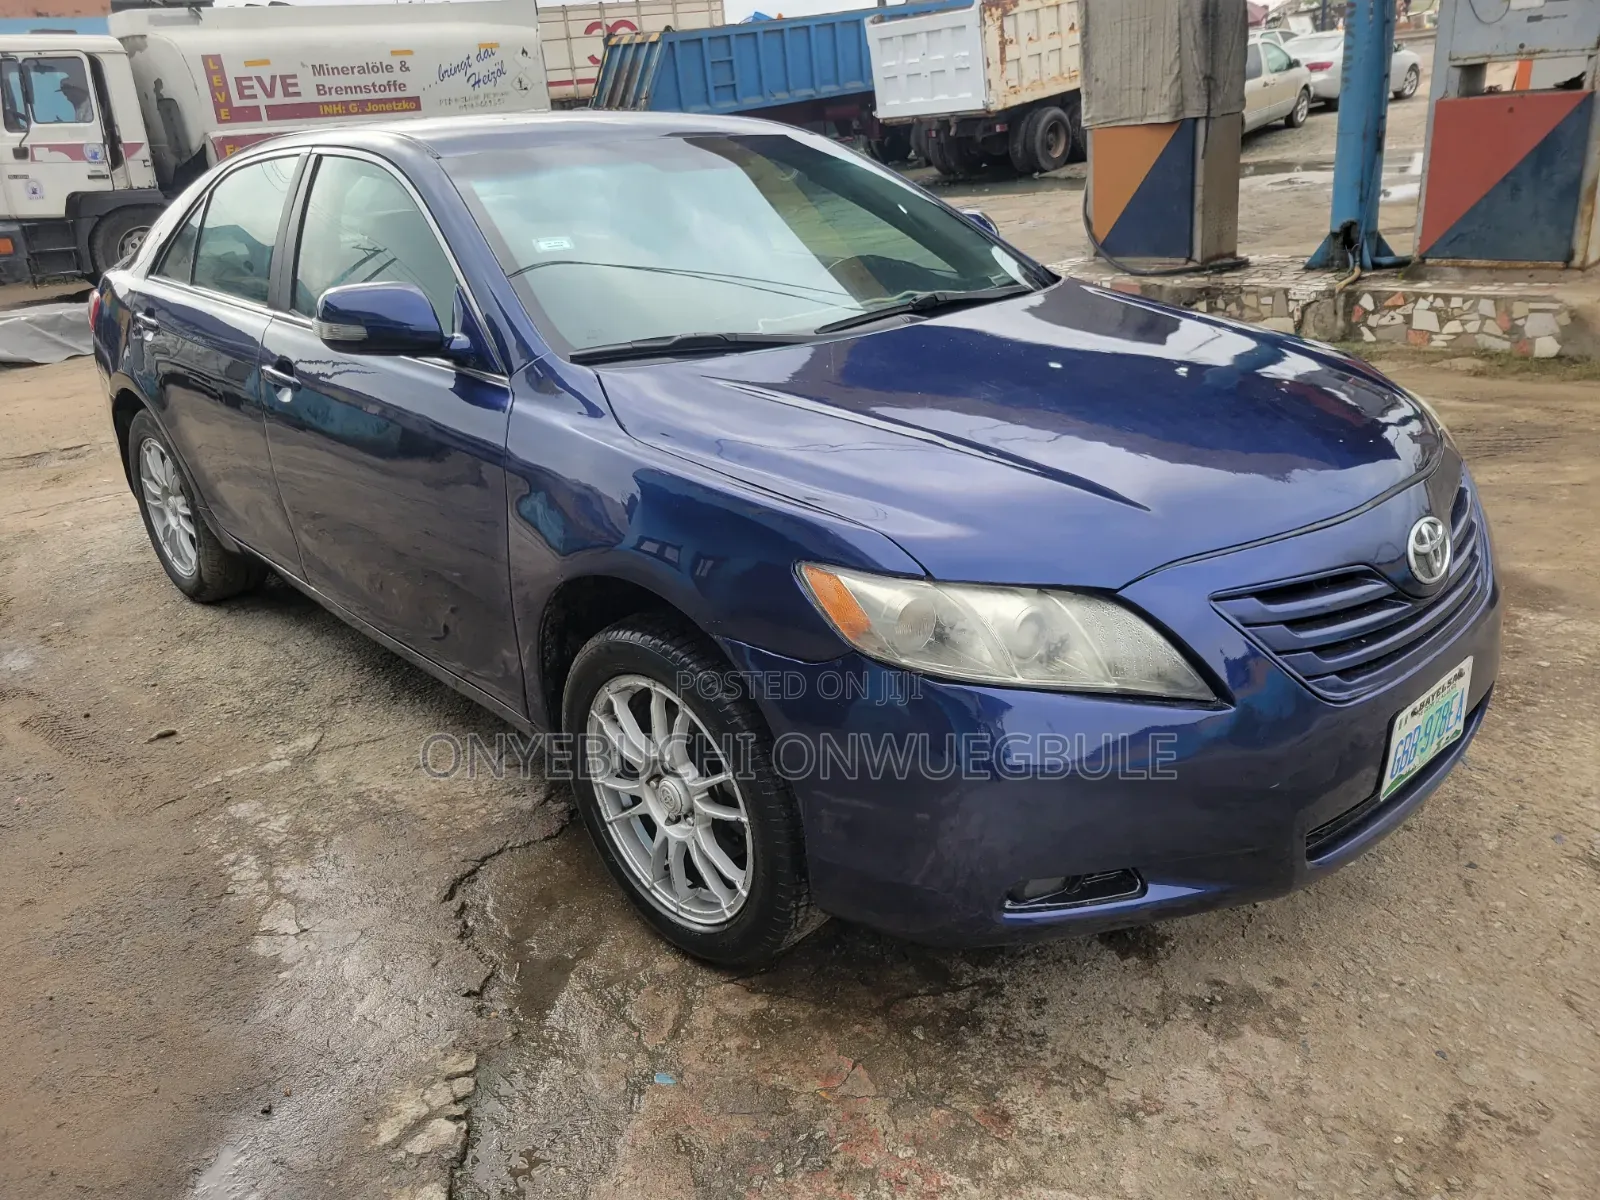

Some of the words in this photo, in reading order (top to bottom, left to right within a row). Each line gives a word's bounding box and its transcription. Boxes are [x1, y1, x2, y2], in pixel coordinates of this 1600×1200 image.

[311, 60, 394, 77] Mineralöle
[399, 60, 411, 73] &
[466, 60, 507, 91] Heizöl
[207, 58, 231, 120] LEVE
[315, 79, 407, 97] Brennstoffe
[319, 104, 346, 115] INH:
[364, 100, 416, 113] Jonetzko
